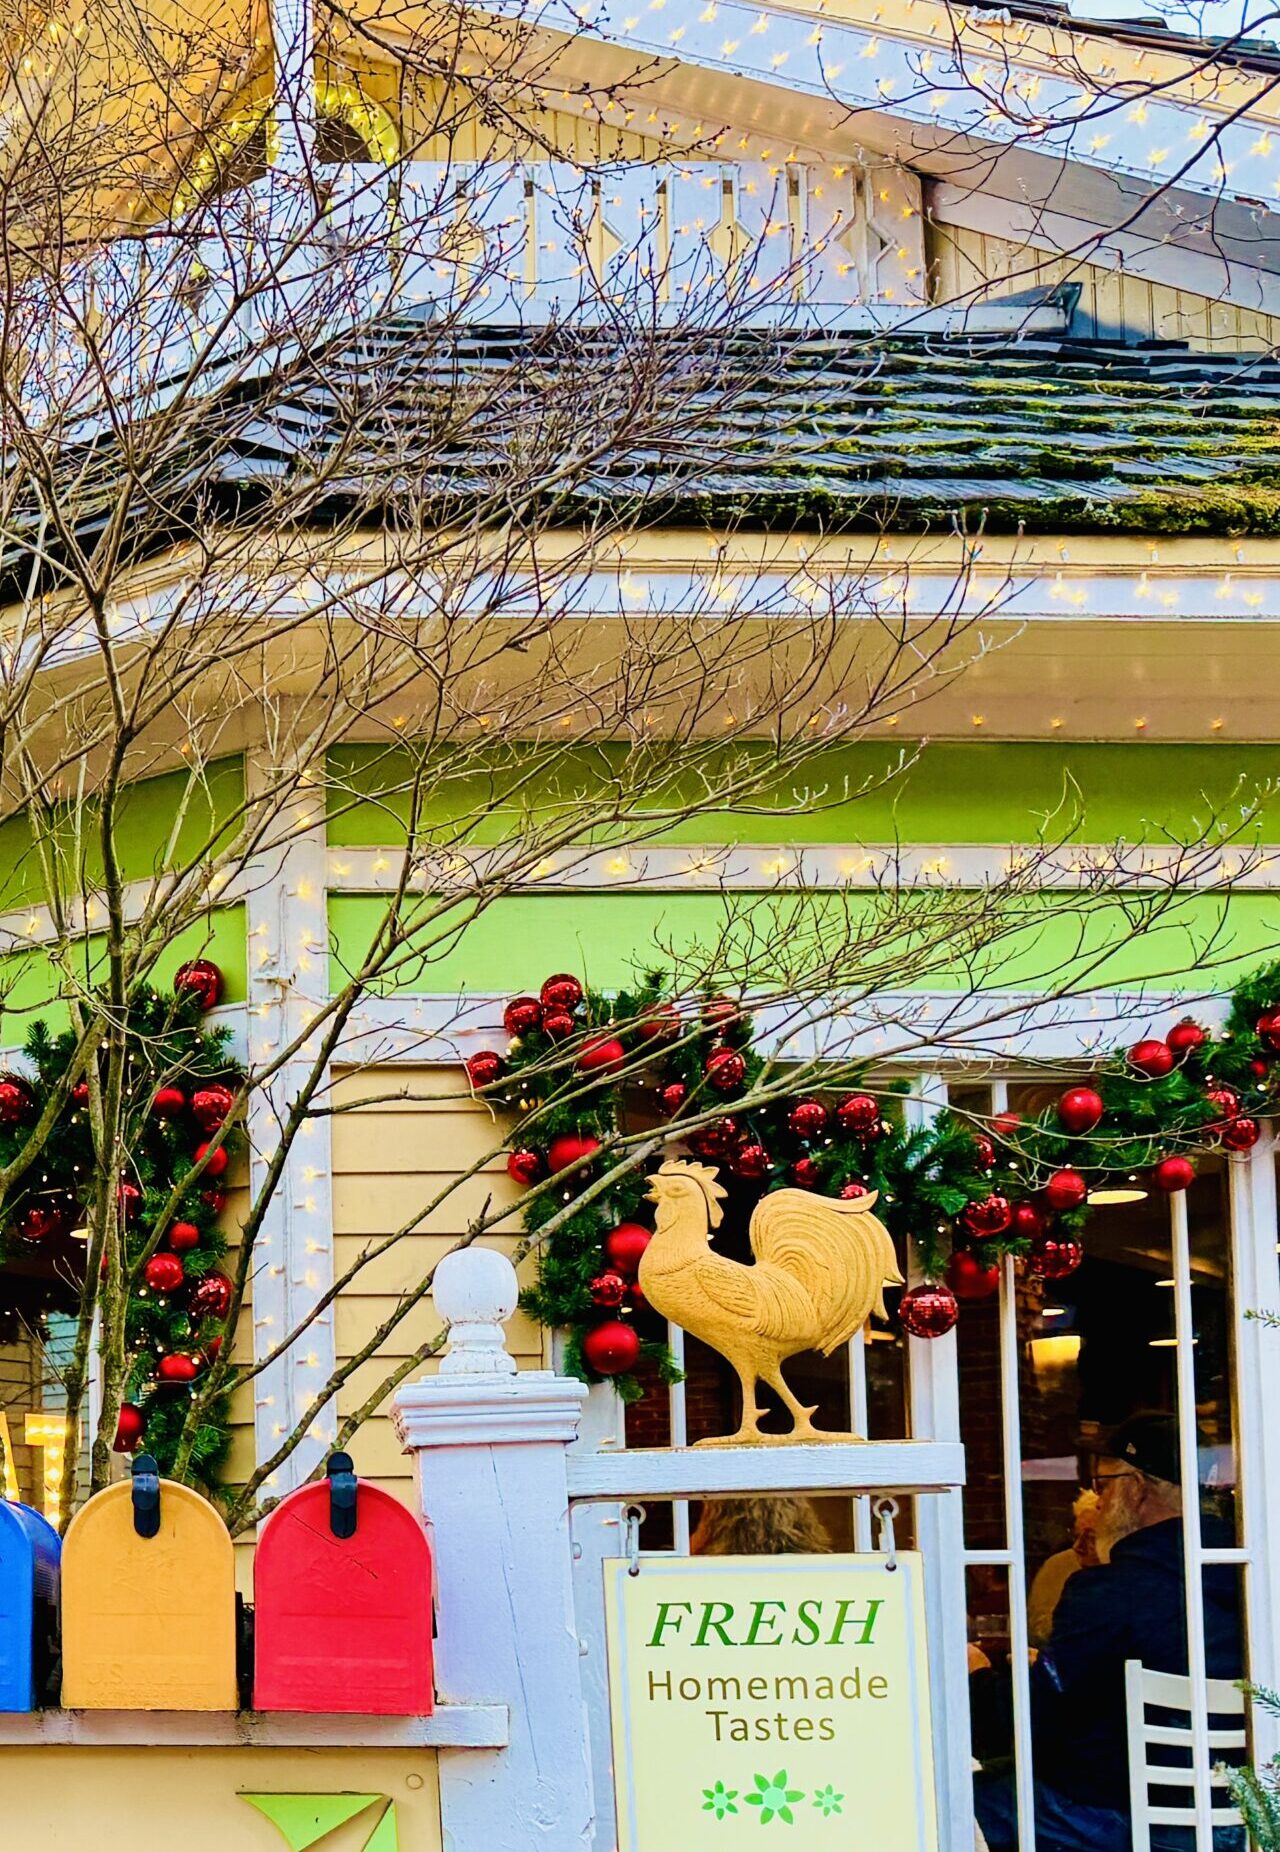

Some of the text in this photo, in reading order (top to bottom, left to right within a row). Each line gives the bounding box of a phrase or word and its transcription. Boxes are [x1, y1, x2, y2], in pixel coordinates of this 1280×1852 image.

[645, 1599, 886, 1648] FRESH
[648, 1667, 889, 1702] Homemade
[705, 1711, 836, 1742] Tastes
